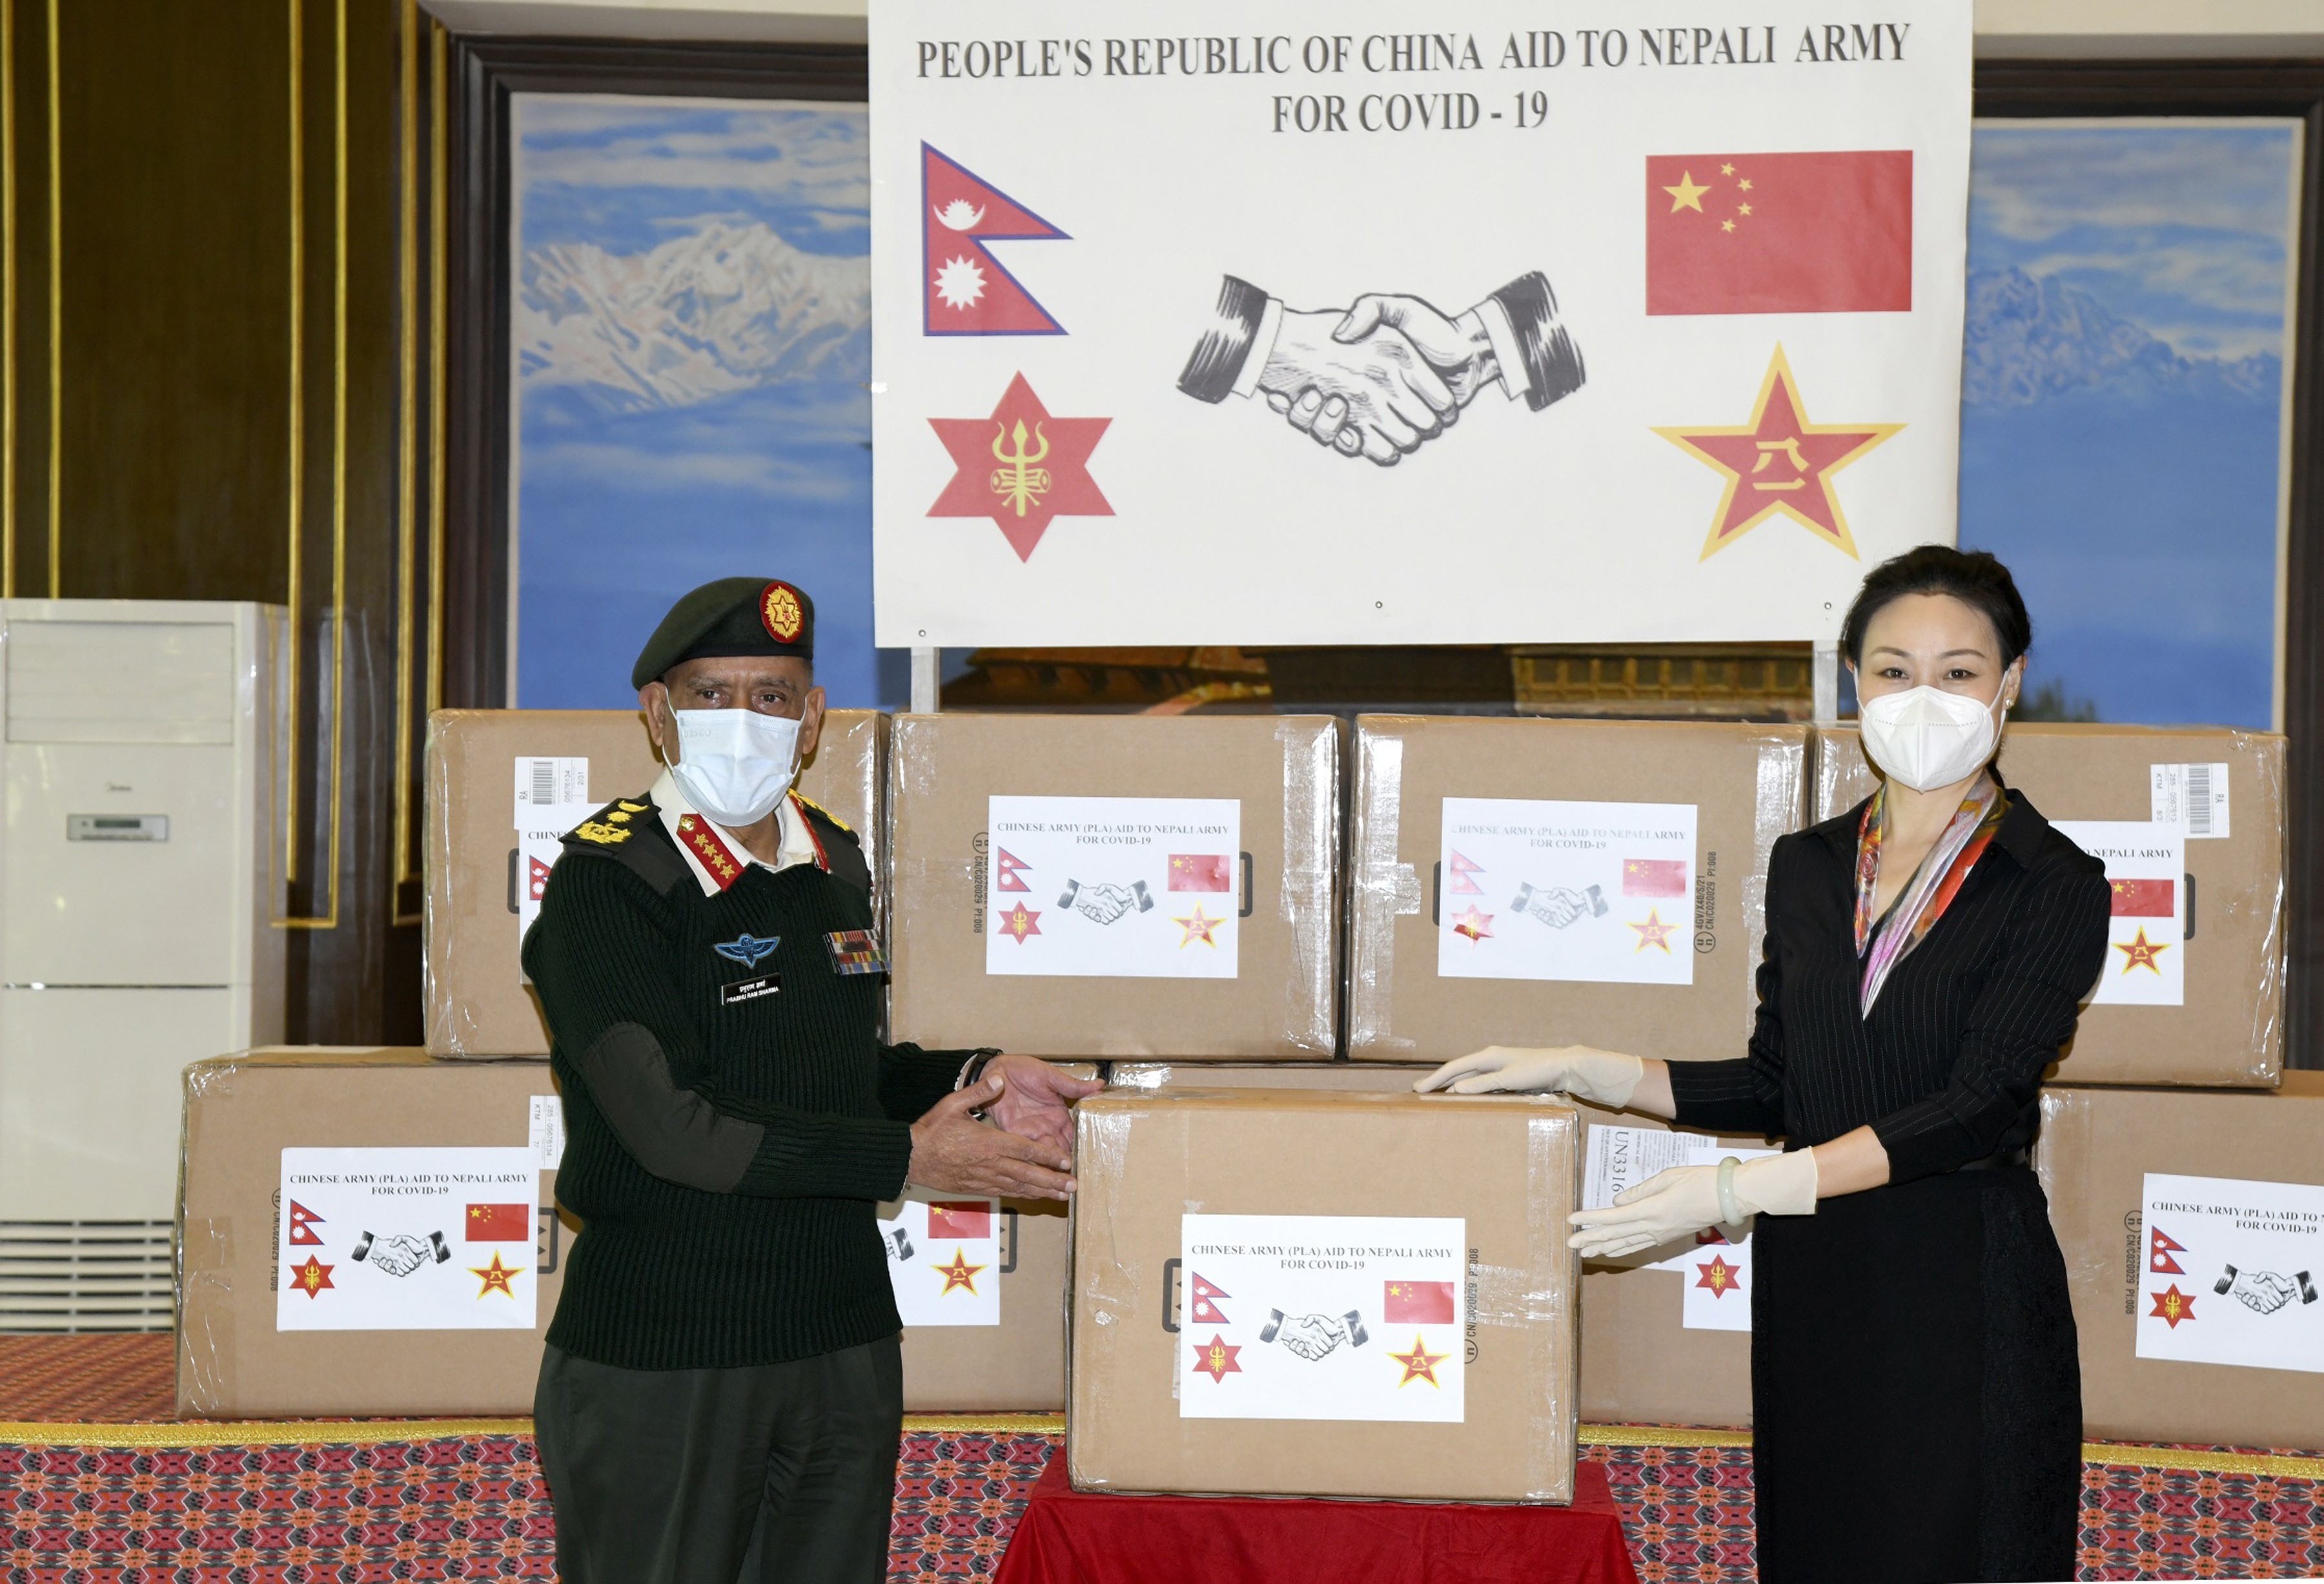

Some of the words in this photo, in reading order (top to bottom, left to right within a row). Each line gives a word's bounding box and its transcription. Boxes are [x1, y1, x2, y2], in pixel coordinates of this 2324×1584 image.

[916, 39, 1092, 79] PEOPLE'S
[1103, 36, 1291, 76] REPUBLIC
[1303, 36, 1352, 74] OF
[1361, 33, 1484, 72] CHINA
[1499, 31, 1566, 69] AID
[1576, 29, 1628, 67] TO
[1638, 26, 1777, 66] NEPALI
[1794, 23, 1911, 62] ARMY
[1271, 95, 1349, 132] FOR
[1358, 93, 1480, 132] COVID
[1514, 90, 1548, 128] 19
[528, 831, 566, 839] CHINE
[997, 823, 1046, 832] CHINESE
[1084, 824, 1112, 834] (PLA)
[1114, 825, 1134, 833] AID
[1154, 825, 1193, 834] NEPALI
[1451, 824, 1500, 836] CHINESE
[1502, 826, 1535, 836] ARMY
[1537, 827, 1567, 838] (PLA)
[1567, 828, 1589, 838] AID
[1591, 828, 1608, 840] TO
[1609, 829, 1650, 839] NEPALI
[1652, 830, 1686, 839] ARMY
[1077, 836, 1099, 845] FOR
[1101, 836, 1151, 845] COVID-19
[1531, 839, 1553, 848] FOR
[1555, 839, 1606, 849] COVID-19
[2138, 849, 2172, 858] ARMY
[1707, 851, 1717, 876] PI:008
[1706, 881, 1715, 930] CN/C020029
[973, 909, 983, 933] PI:008
[759, 986, 779, 995] SHARMA
[1611, 1131, 1629, 1192] UN3316
[290, 1175, 340, 1184] CHINESE
[343, 1175, 376, 1183] ARMY
[379, 1175, 408, 1184] (PLA)
[433, 1174, 449, 1183] TO
[453, 1174, 491, 1183] NEPALI
[495, 1174, 528, 1182] ARMY
[372, 1186, 394, 1195] FOR
[397, 1186, 449, 1195] COVID-19
[2152, 1201, 2203, 1213] CHINESE
[2206, 1206, 2241, 1216] ARMY
[2244, 1209, 2274, 1220] (PLA)
[2278, 1211, 2298, 1220] AID
[2301, 1213, 2318, 1222] TO
[2236, 1220, 2259, 1229] FOR
[2263, 1222, 2317, 1233] COVID-19
[1192, 1245, 1245, 1255] CHINESE
[1249, 1246, 1285, 1255] ARMY
[1289, 1246, 1320, 1257] (PLA)
[1323, 1248, 1345, 1256] AID
[1348, 1248, 1365, 1257] TO
[1369, 1248, 1412, 1257] NEPALI
[1416, 1249, 1452, 1258] ARMY
[1281, 1259, 1306, 1269] FOR
[1309, 1260, 1364, 1270] COVID-19
[2126, 1234, 2135, 1284] CN/C020029
[2125, 1288, 2135, 1315] PI:008
